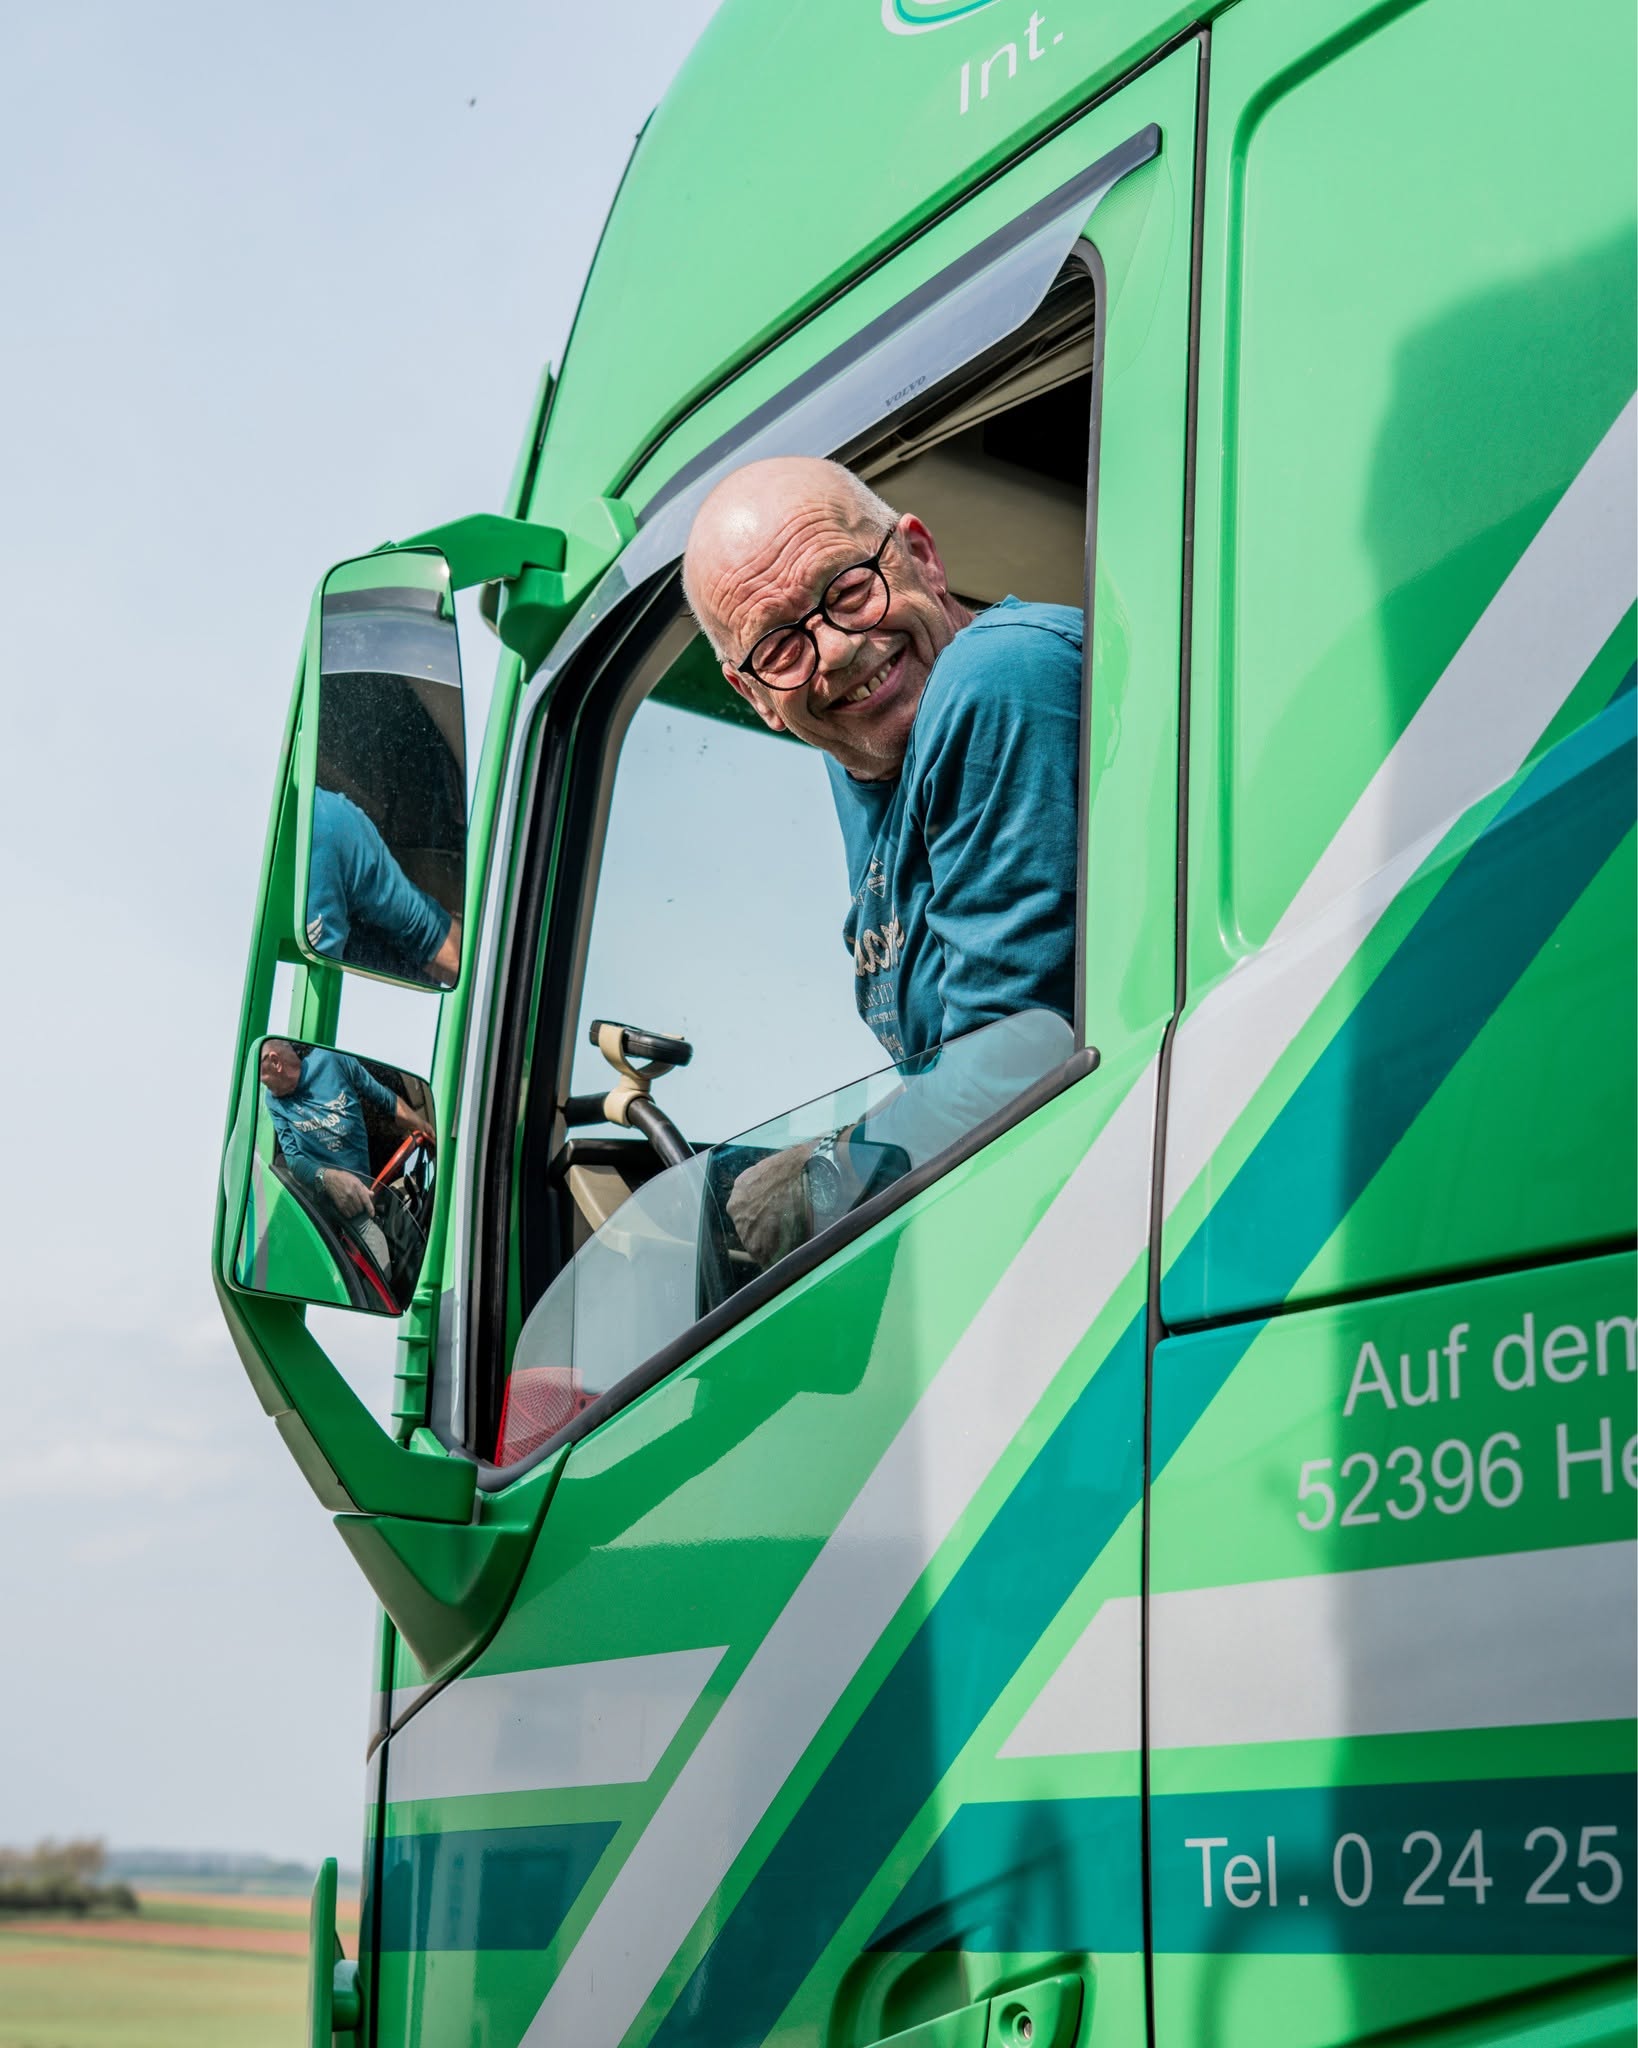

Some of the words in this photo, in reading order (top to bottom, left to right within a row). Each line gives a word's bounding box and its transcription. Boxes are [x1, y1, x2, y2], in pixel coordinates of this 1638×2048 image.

[960, 9, 1065, 116] Int.
[885, 375, 926, 407] VOLVO
[1342, 1324, 1469, 1417] Auf
[1295, 1431, 1524, 1533] 52396
[1184, 1836, 1310, 1909] Tel.
[1333, 1833, 1374, 1908] 0
[1401, 1828, 1494, 1906] 24
[1524, 1825, 1624, 1906] 25
